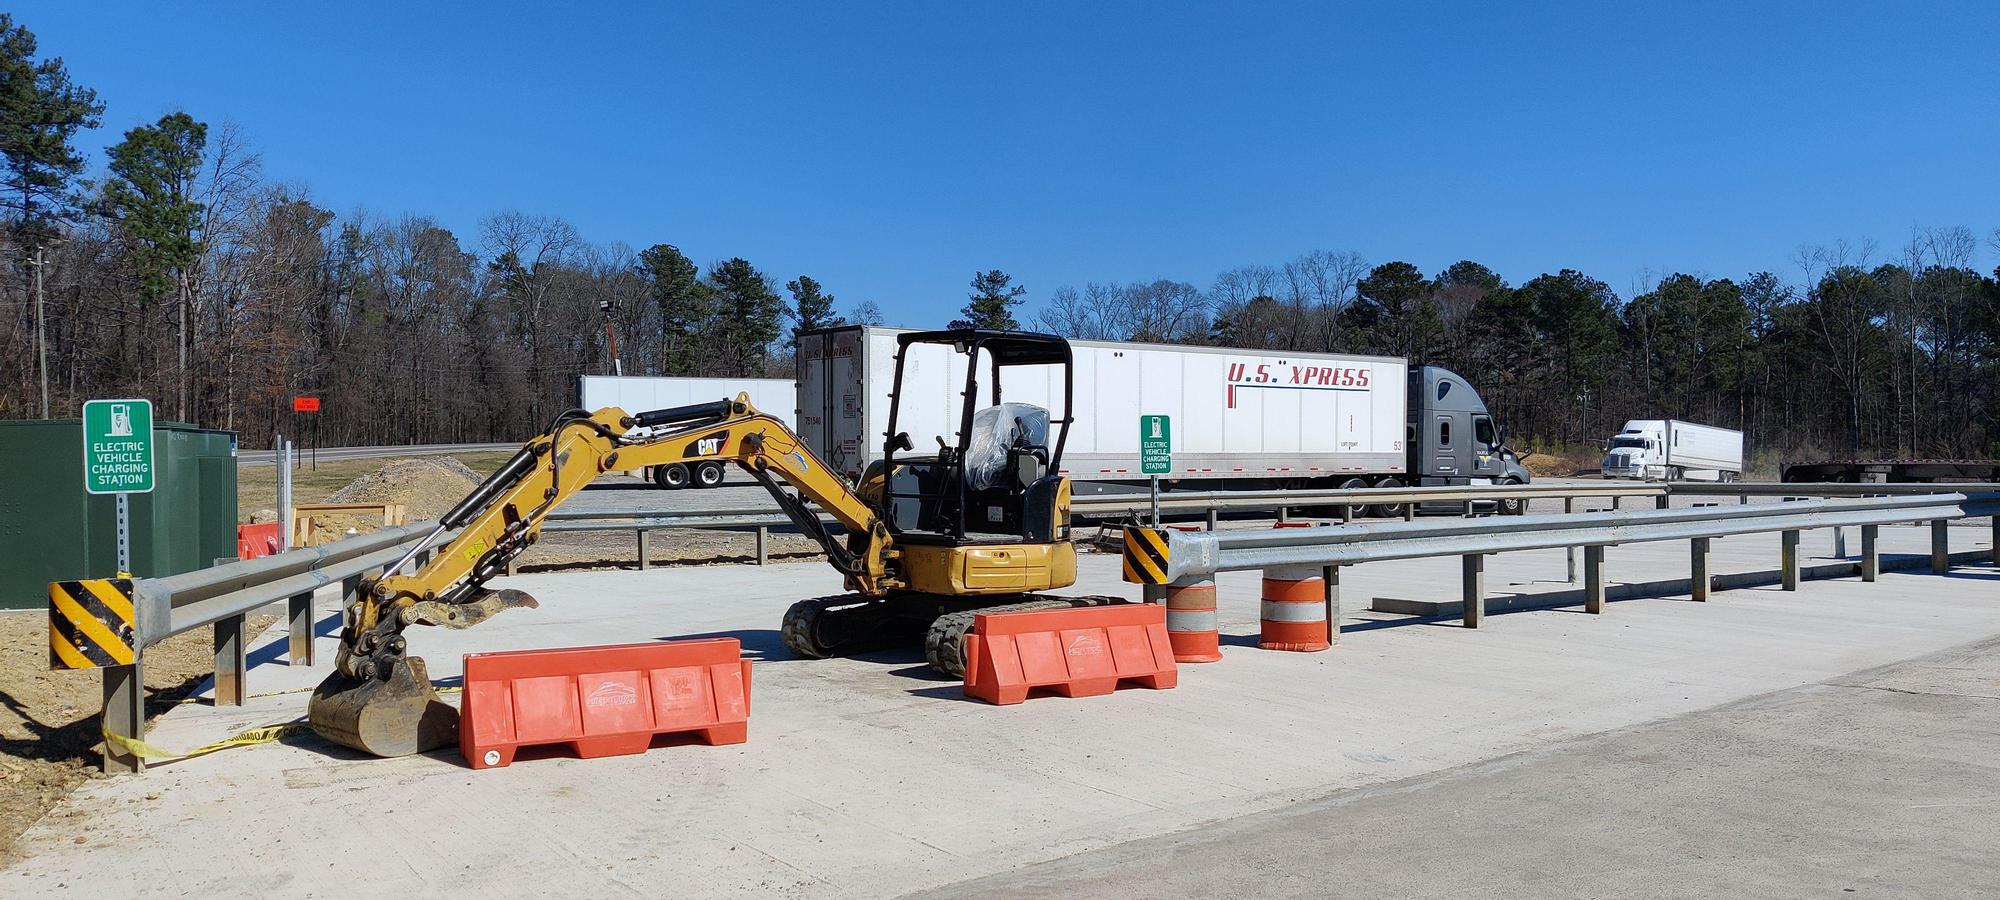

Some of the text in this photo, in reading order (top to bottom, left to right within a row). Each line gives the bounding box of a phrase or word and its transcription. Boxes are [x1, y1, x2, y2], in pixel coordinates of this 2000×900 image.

[1228, 363, 1371, 387] U.S. XPRESS
[94, 442, 145, 452] ELECTRIC
[697, 440, 718, 456] CAT
[97, 453, 142, 462] VEHICLE
[92, 464, 148, 474] CHARGING
[99, 475, 143, 485] STATION
